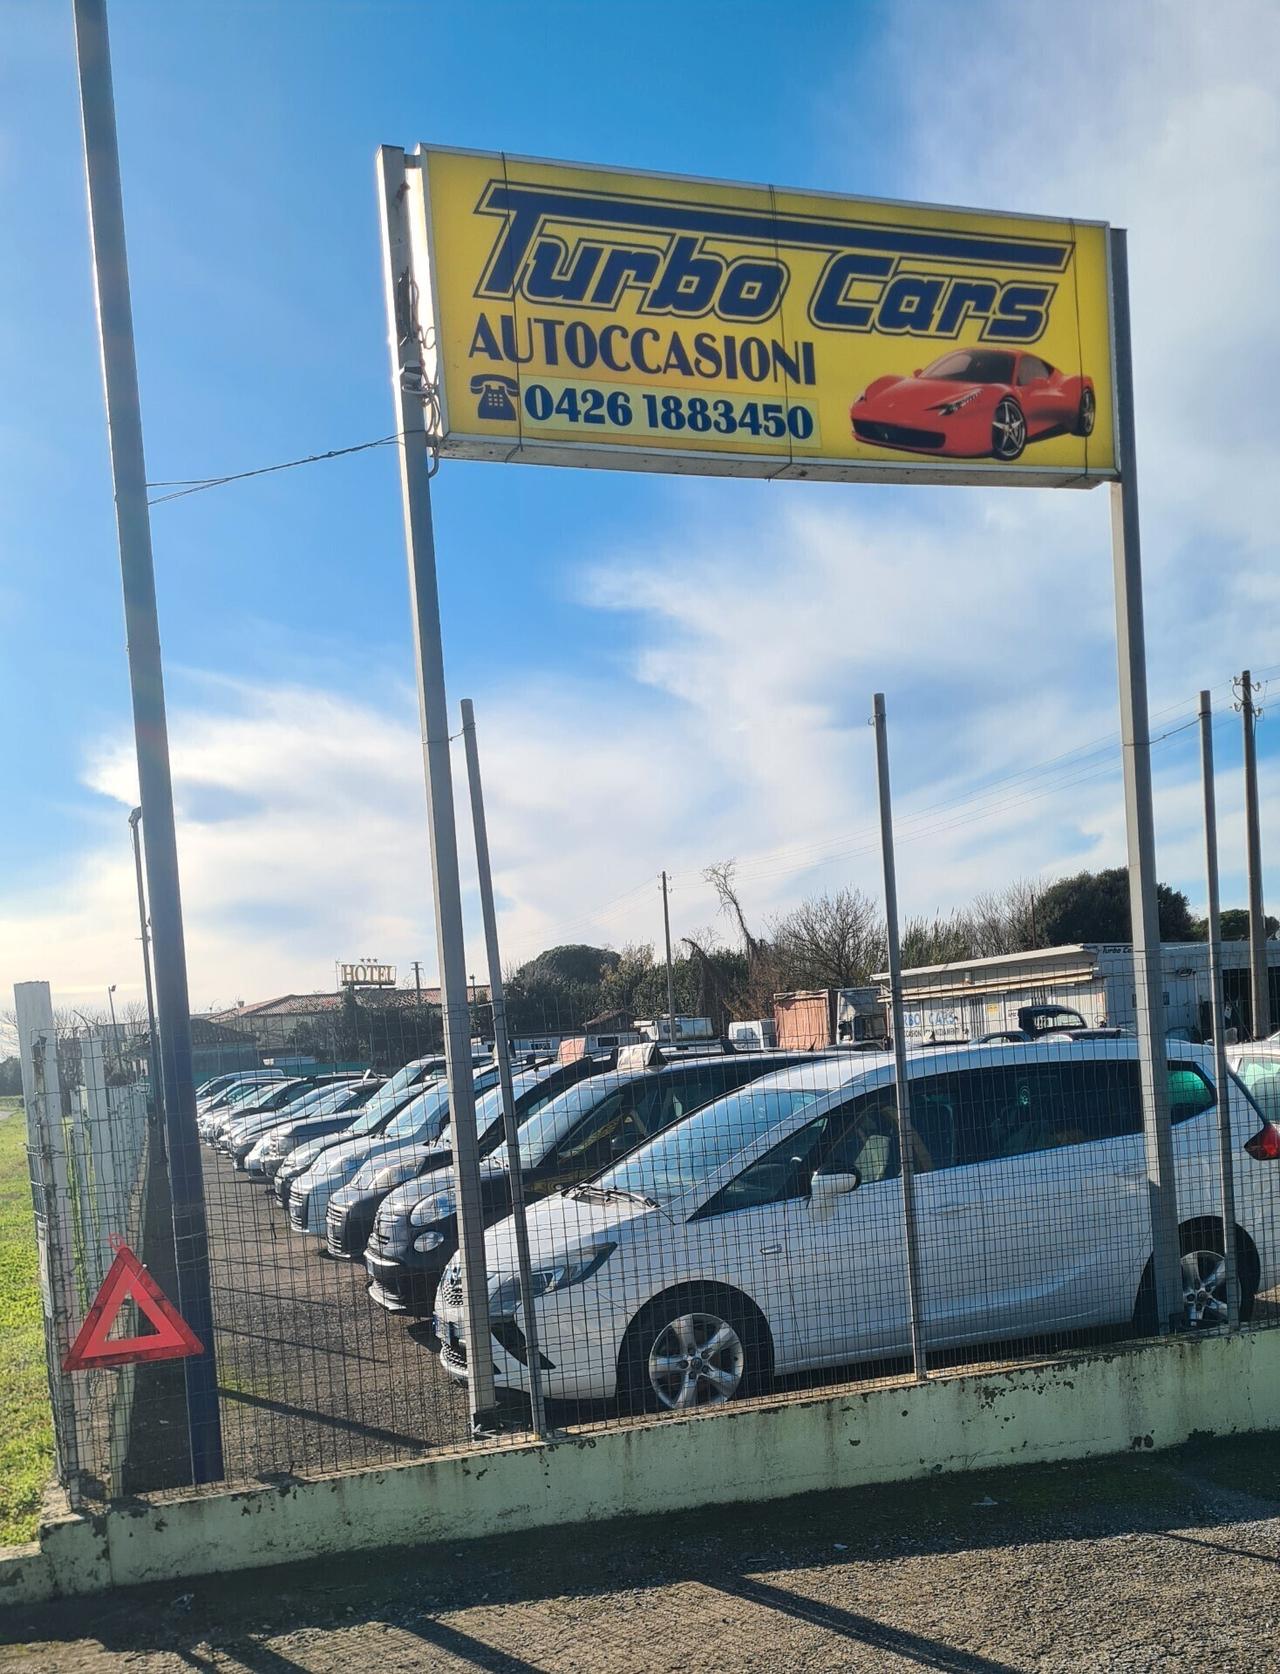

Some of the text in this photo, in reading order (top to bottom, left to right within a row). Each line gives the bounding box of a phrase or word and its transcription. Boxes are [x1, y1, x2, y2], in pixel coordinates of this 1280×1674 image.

[473, 179, 1059, 344] Turbo Cars
[468, 312, 816, 386] AUTOCCASIONI
[524, 384, 814, 440] 0426 1883450
[341, 964, 396, 983] HOTEL
